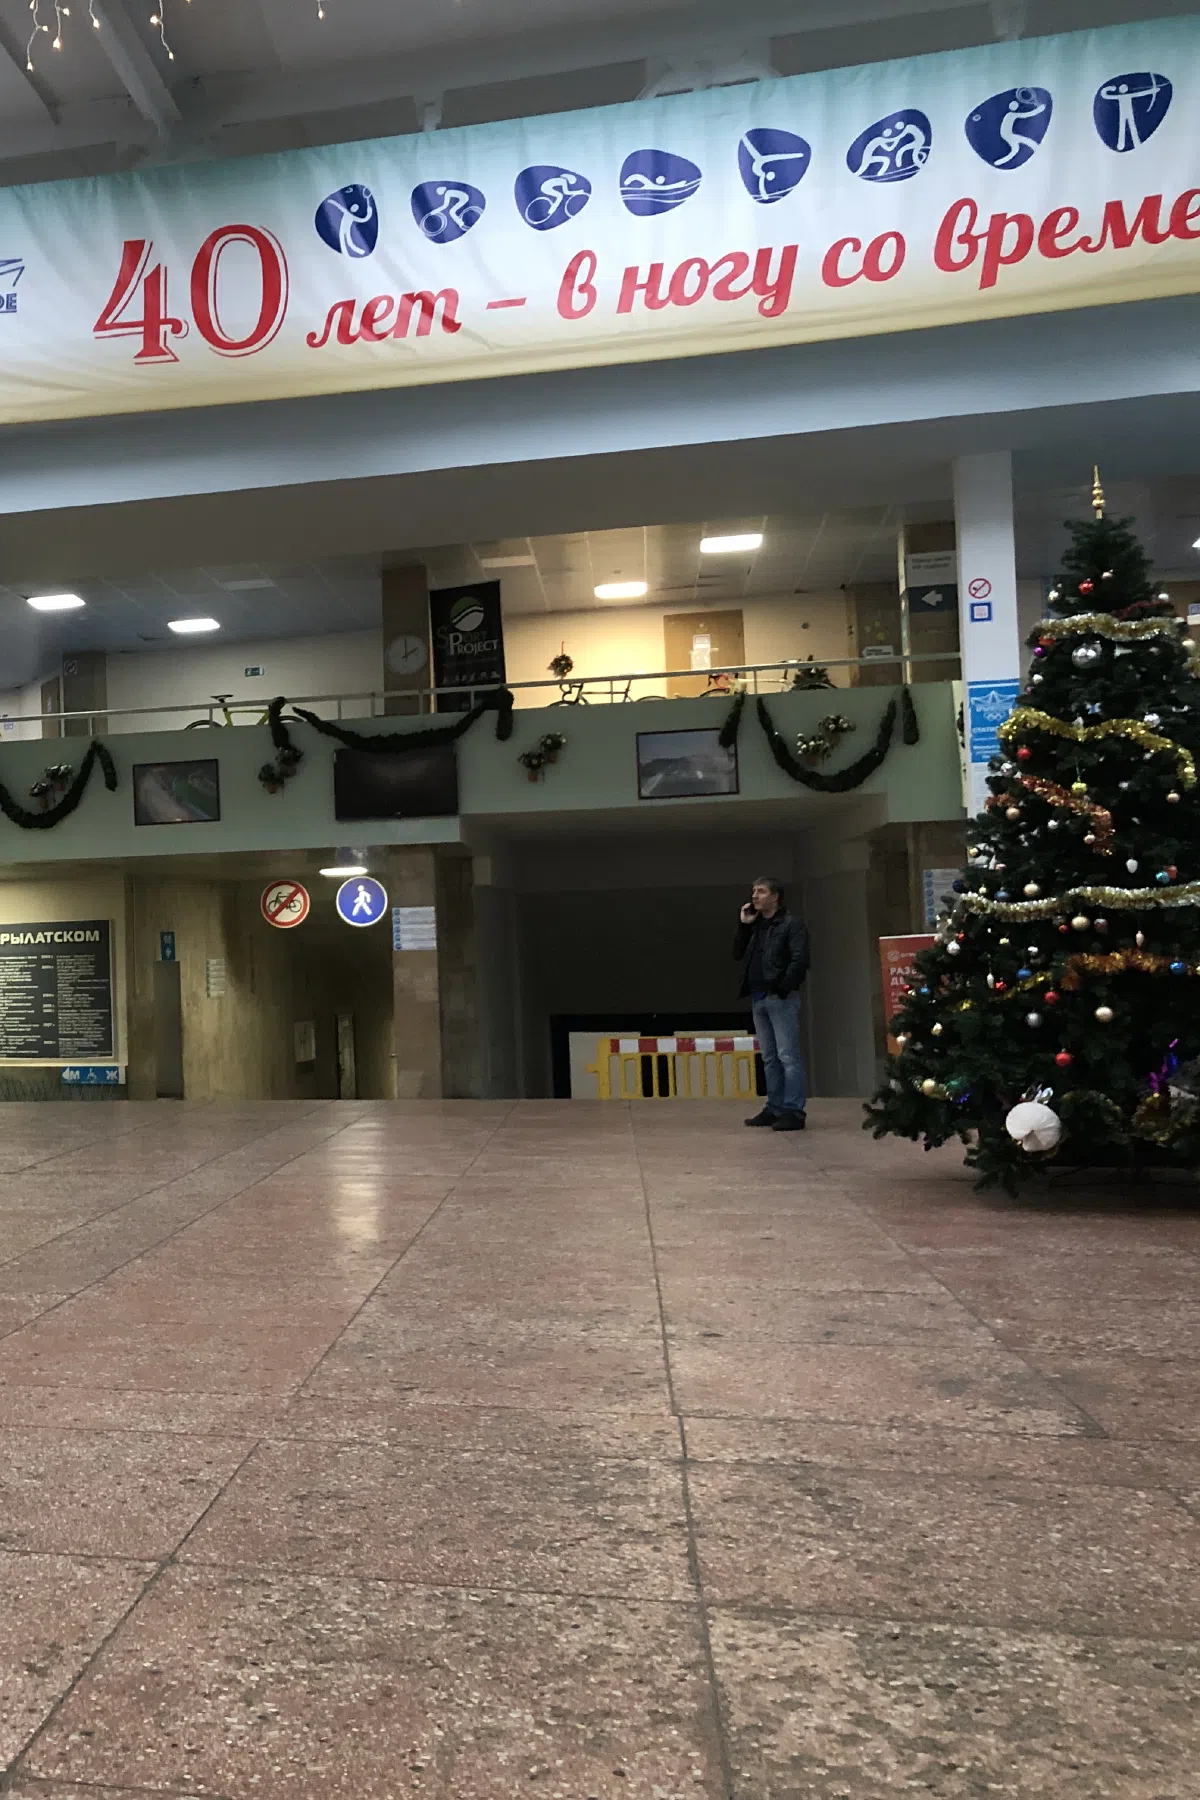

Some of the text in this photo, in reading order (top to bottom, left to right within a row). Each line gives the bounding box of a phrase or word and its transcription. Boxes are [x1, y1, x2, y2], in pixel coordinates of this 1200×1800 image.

[93, 223, 289, 366] 40
[306, 287, 462, 349] лет
[557, 249, 597, 320] в
[616, 243, 799, 318] ногу
[822, 230, 907, 288] со
